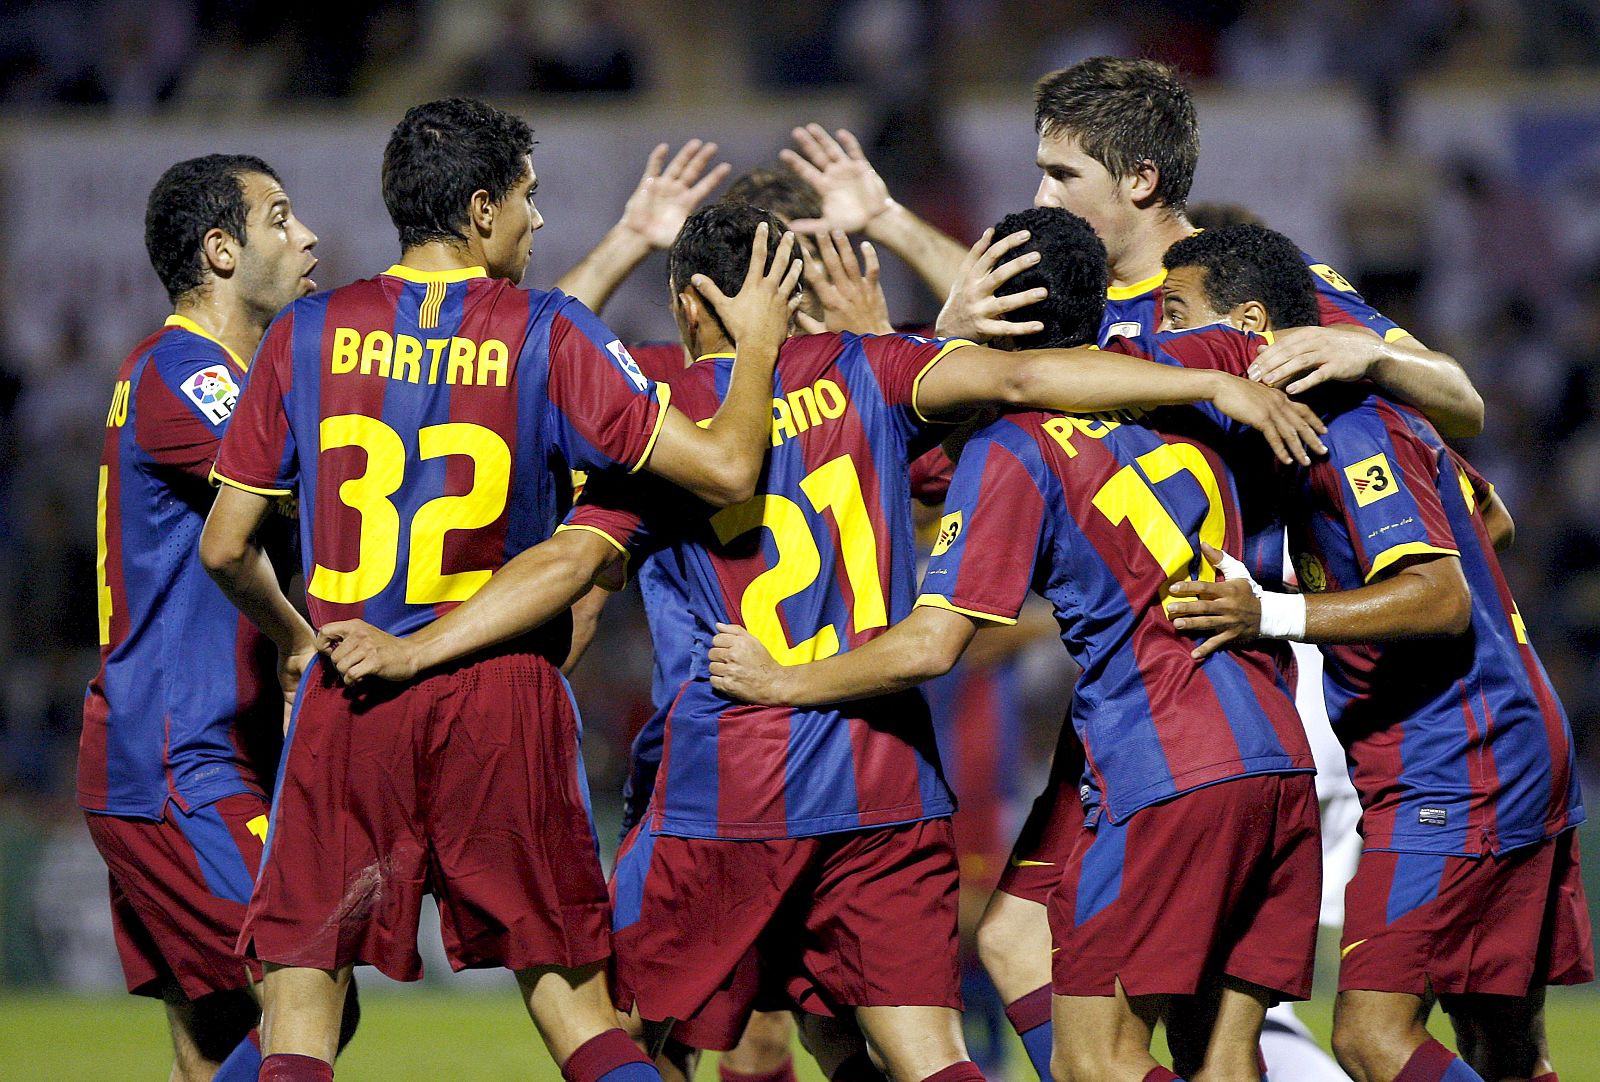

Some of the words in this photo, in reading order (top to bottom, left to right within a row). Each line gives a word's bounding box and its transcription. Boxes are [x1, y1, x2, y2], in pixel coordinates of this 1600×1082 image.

[331, 327, 509, 387] BARTRA
[307, 413, 512, 604] 32
[708, 453, 888, 667] 21
[1091, 442, 1226, 621] 17
[1366, 465, 1389, 492] 3
